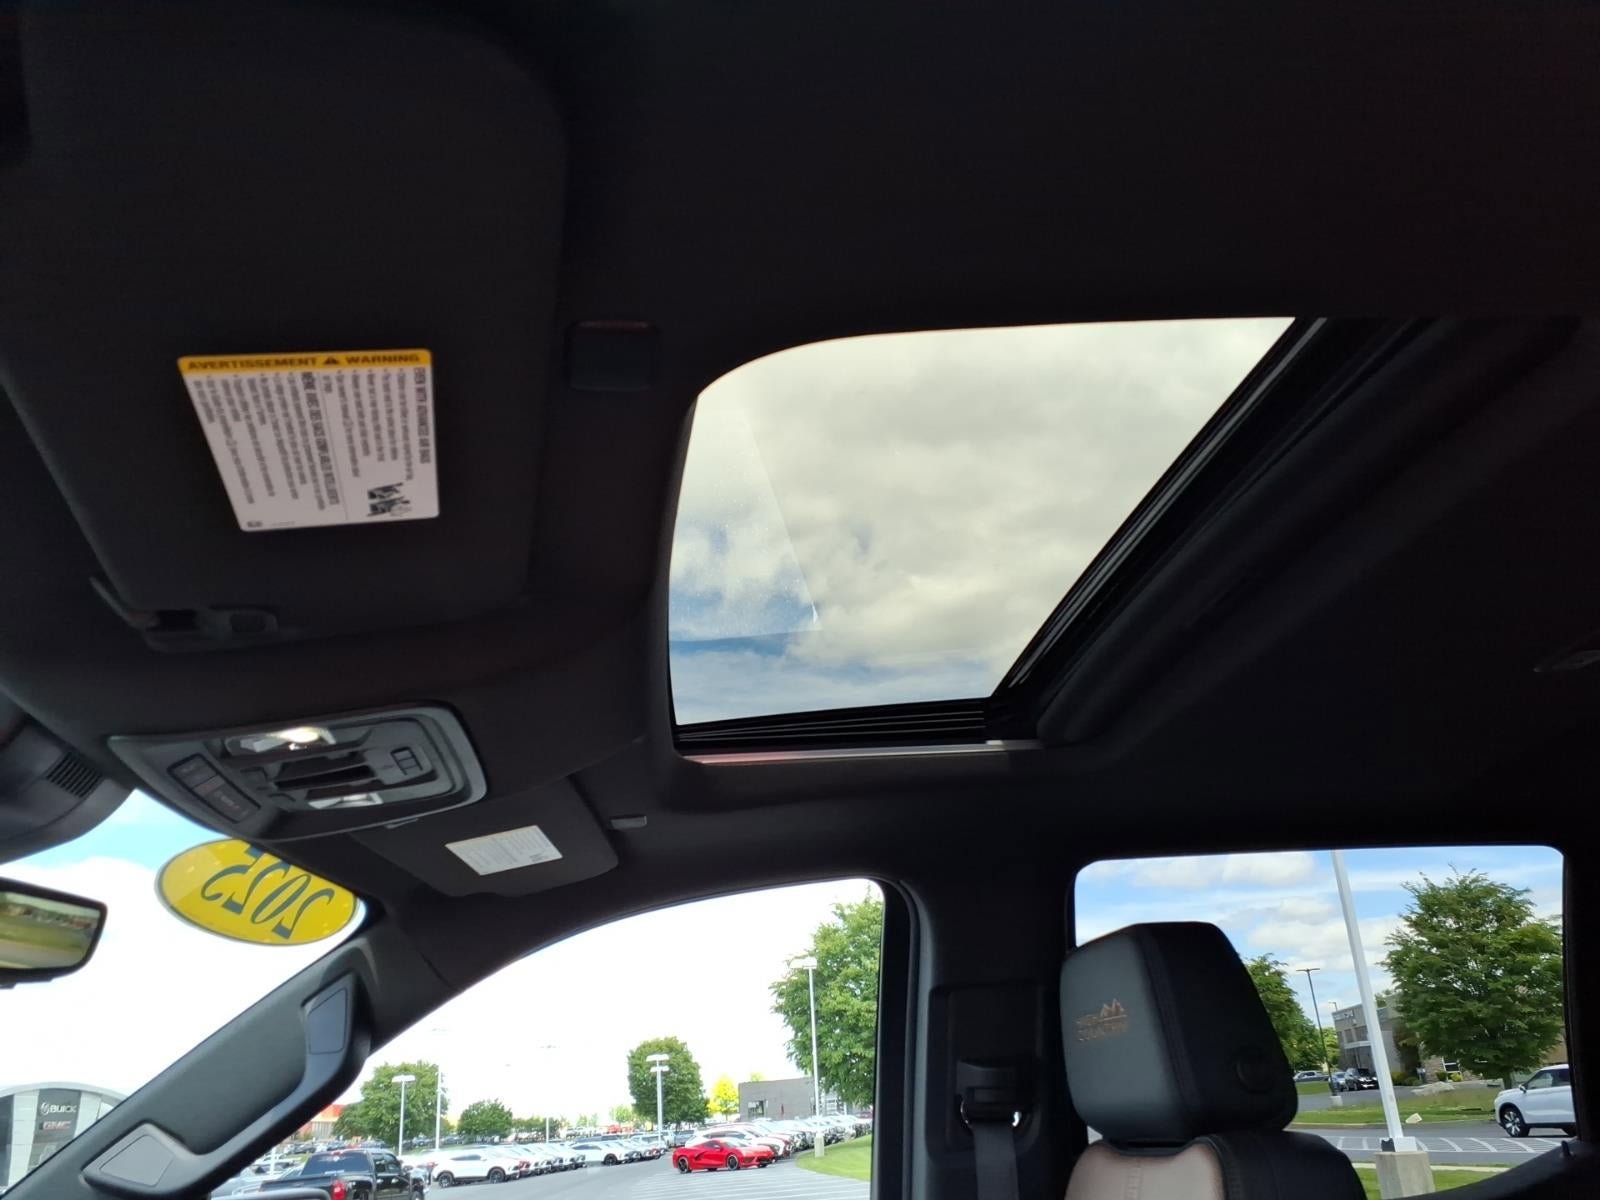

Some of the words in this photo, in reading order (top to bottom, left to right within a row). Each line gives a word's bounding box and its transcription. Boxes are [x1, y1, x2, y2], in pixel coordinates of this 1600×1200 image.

[188, 357, 316, 370] AVERTISSEMENT
[346, 354, 419, 364] WARNING
[50, 1104, 77, 1112] BUICK
